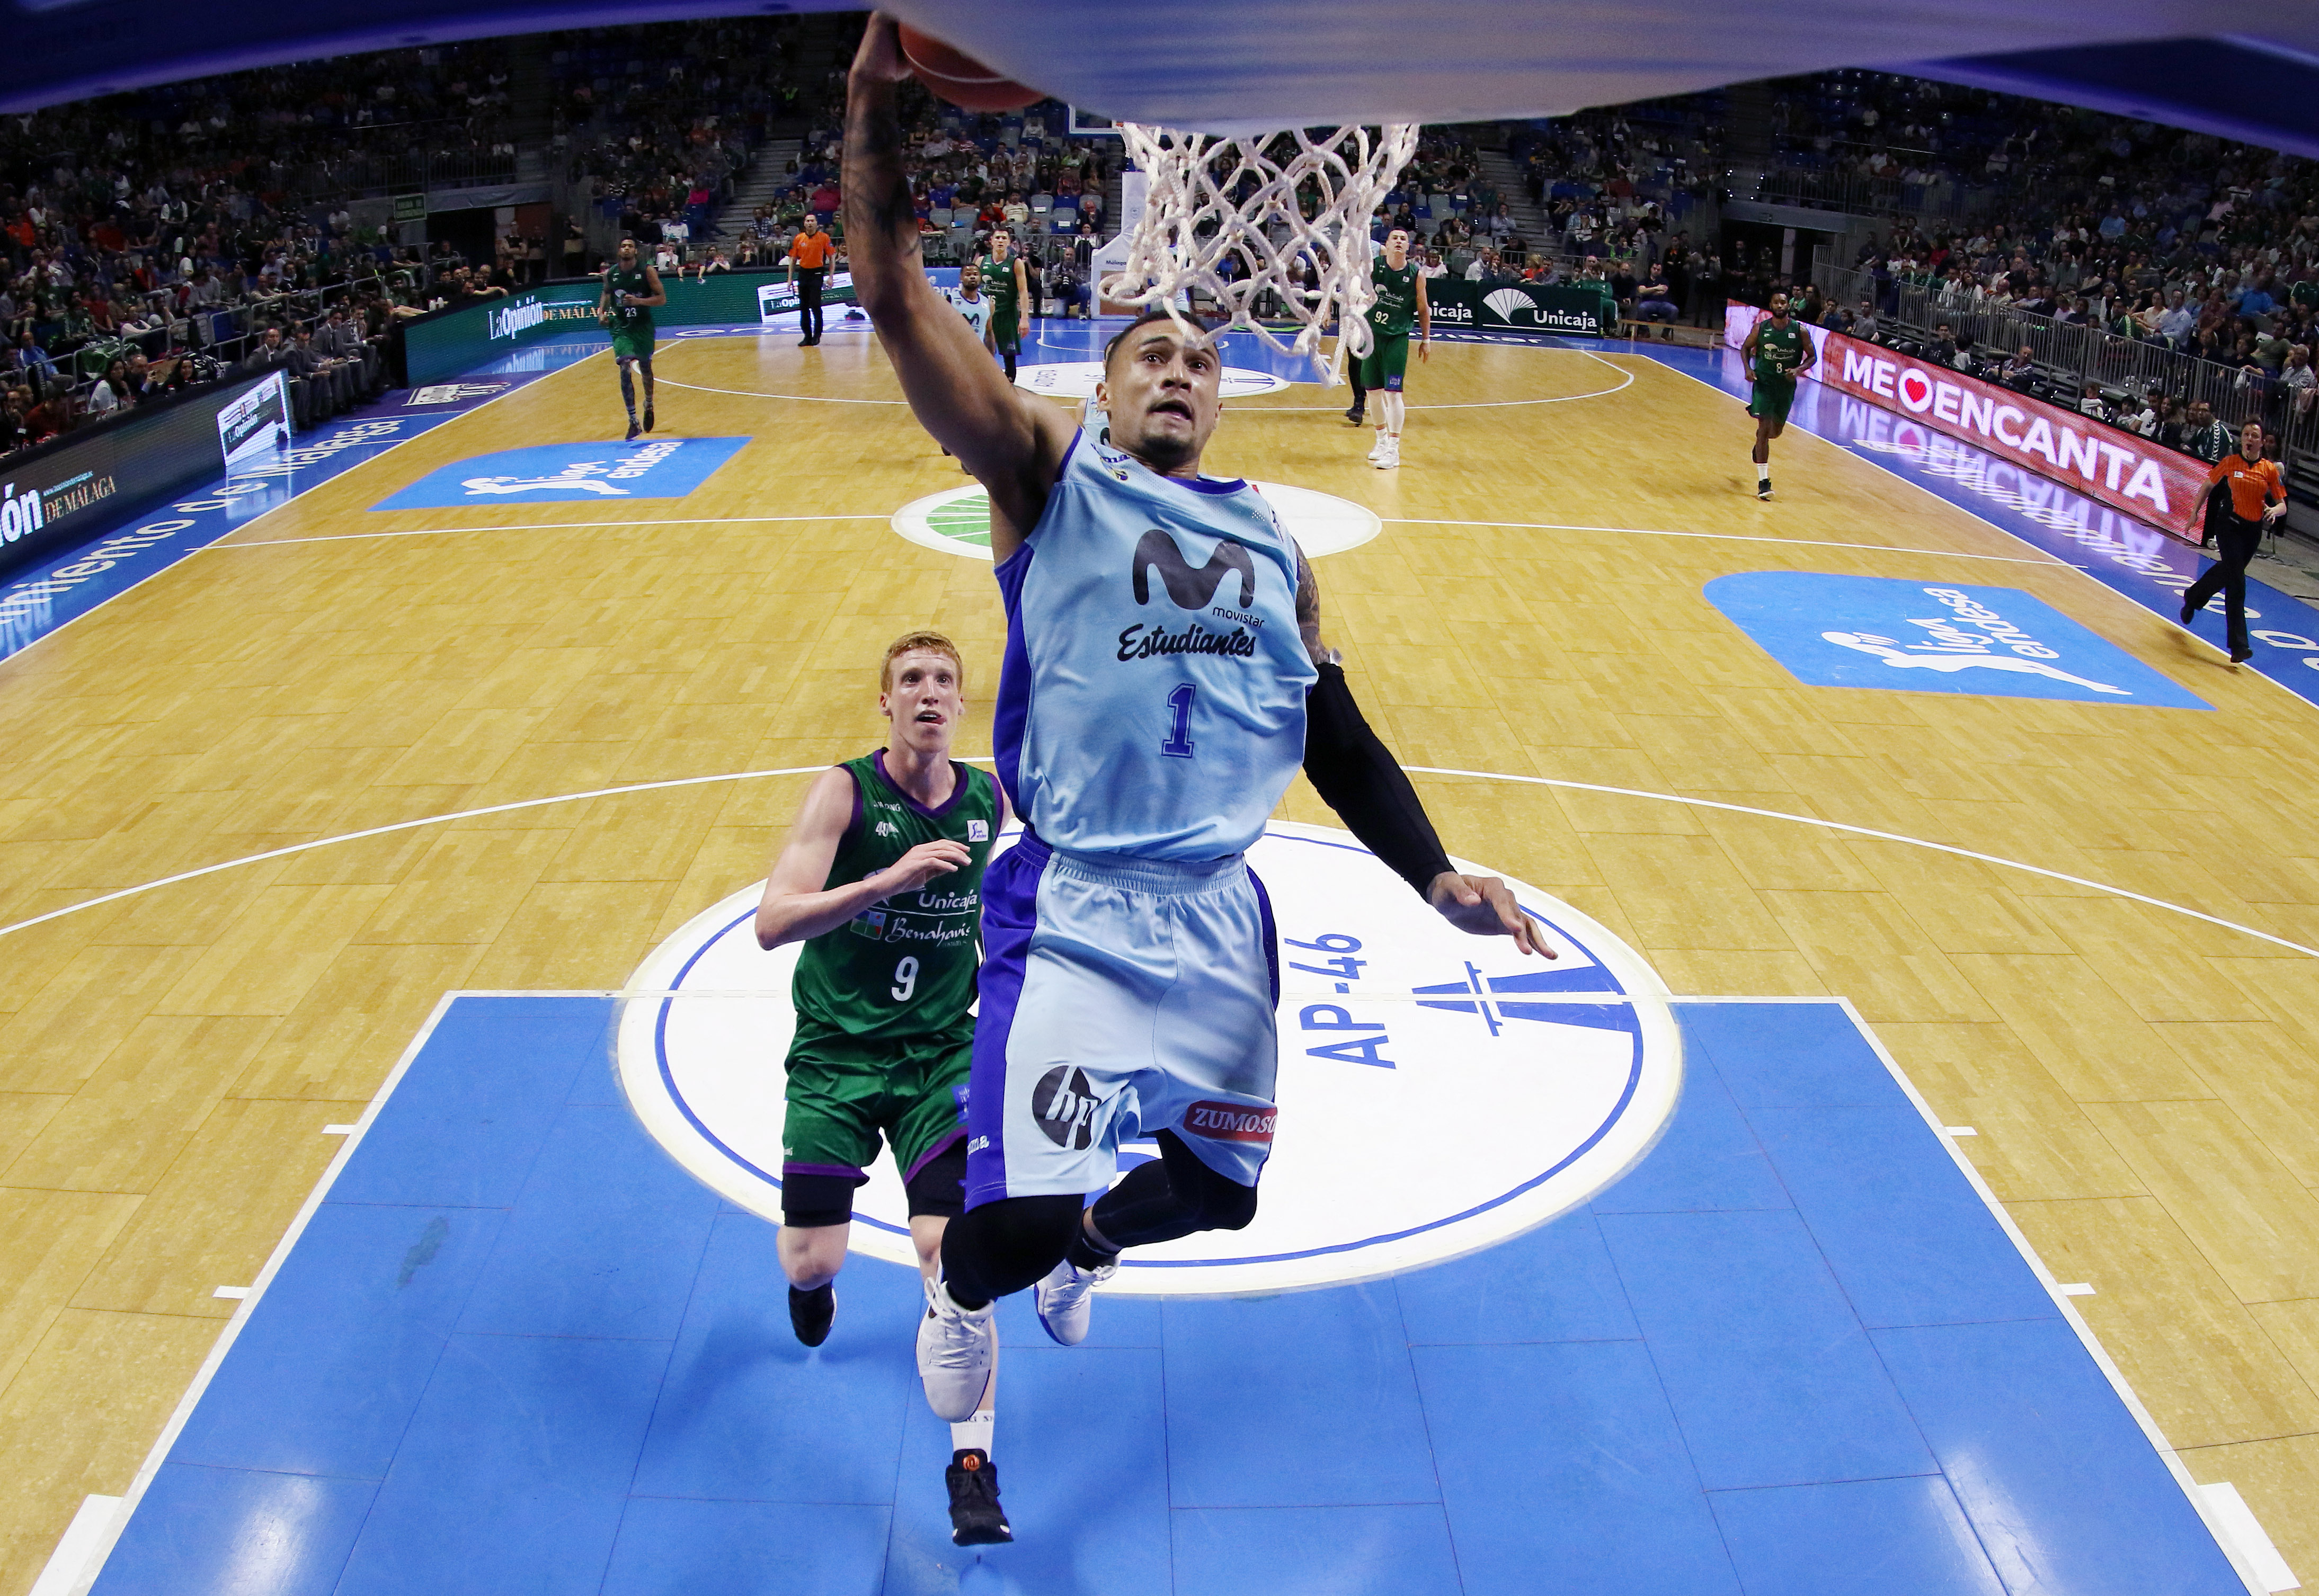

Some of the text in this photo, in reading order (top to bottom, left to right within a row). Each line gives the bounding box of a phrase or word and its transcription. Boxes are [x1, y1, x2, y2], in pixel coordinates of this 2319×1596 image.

[625, 308, 637, 317] 23
[1374, 311, 1389, 325] 92
[1533, 309, 1597, 330] Unicaja
[1776, 362, 1783, 373] 8
[1842, 349, 2171, 513] ME ENCANTA
[606, 441, 684, 479] endesa
[171, 483, 269, 512] de
[1212, 607, 1265, 629] movistar
[1923, 587, 2060, 659] endesa
[1117, 623, 1256, 662] Estudiantes
[1162, 683, 1197, 759] 1
[918, 889, 978, 911] Unicaja
[891, 956, 919, 1002] 9
[1284, 933, 1397, 1069] AP-46
